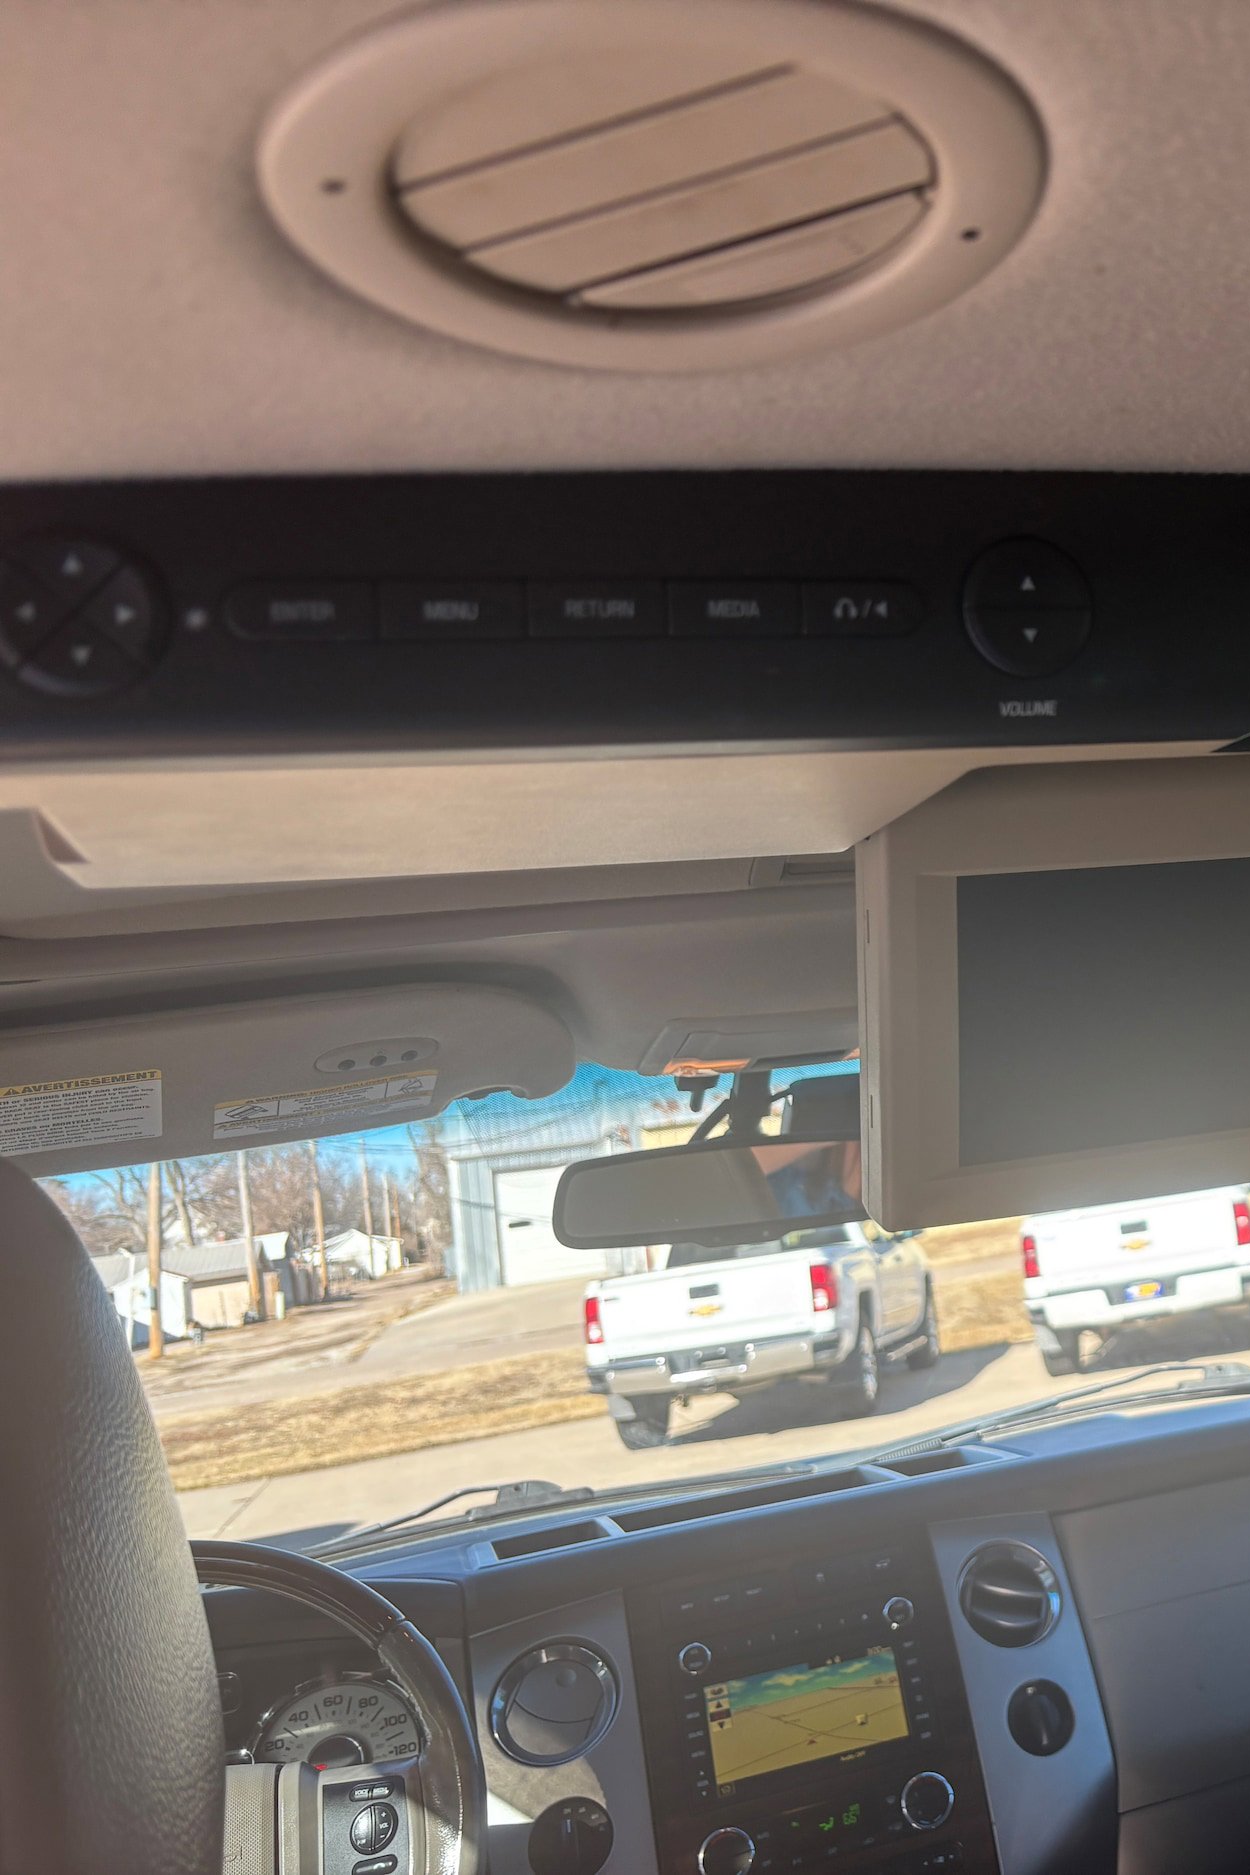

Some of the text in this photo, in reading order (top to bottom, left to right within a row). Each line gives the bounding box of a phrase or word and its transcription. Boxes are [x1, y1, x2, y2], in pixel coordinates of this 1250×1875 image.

[423, 600, 479, 621] MENU
[563, 599, 636, 620] RETURN
[707, 599, 760, 619] MEDIA
[999, 699, 1058, 717] VOLUME
[21, 1070, 157, 1094] AVERTISSEMENT
[323, 1695, 342, 1707] 60
[358, 1695, 378, 1708] 80
[288, 1710, 308, 1722] 40
[383, 1713, 406, 1727] 100
[264, 1738, 284, 1751] 20
[394, 1741, 417, 1755] 120
